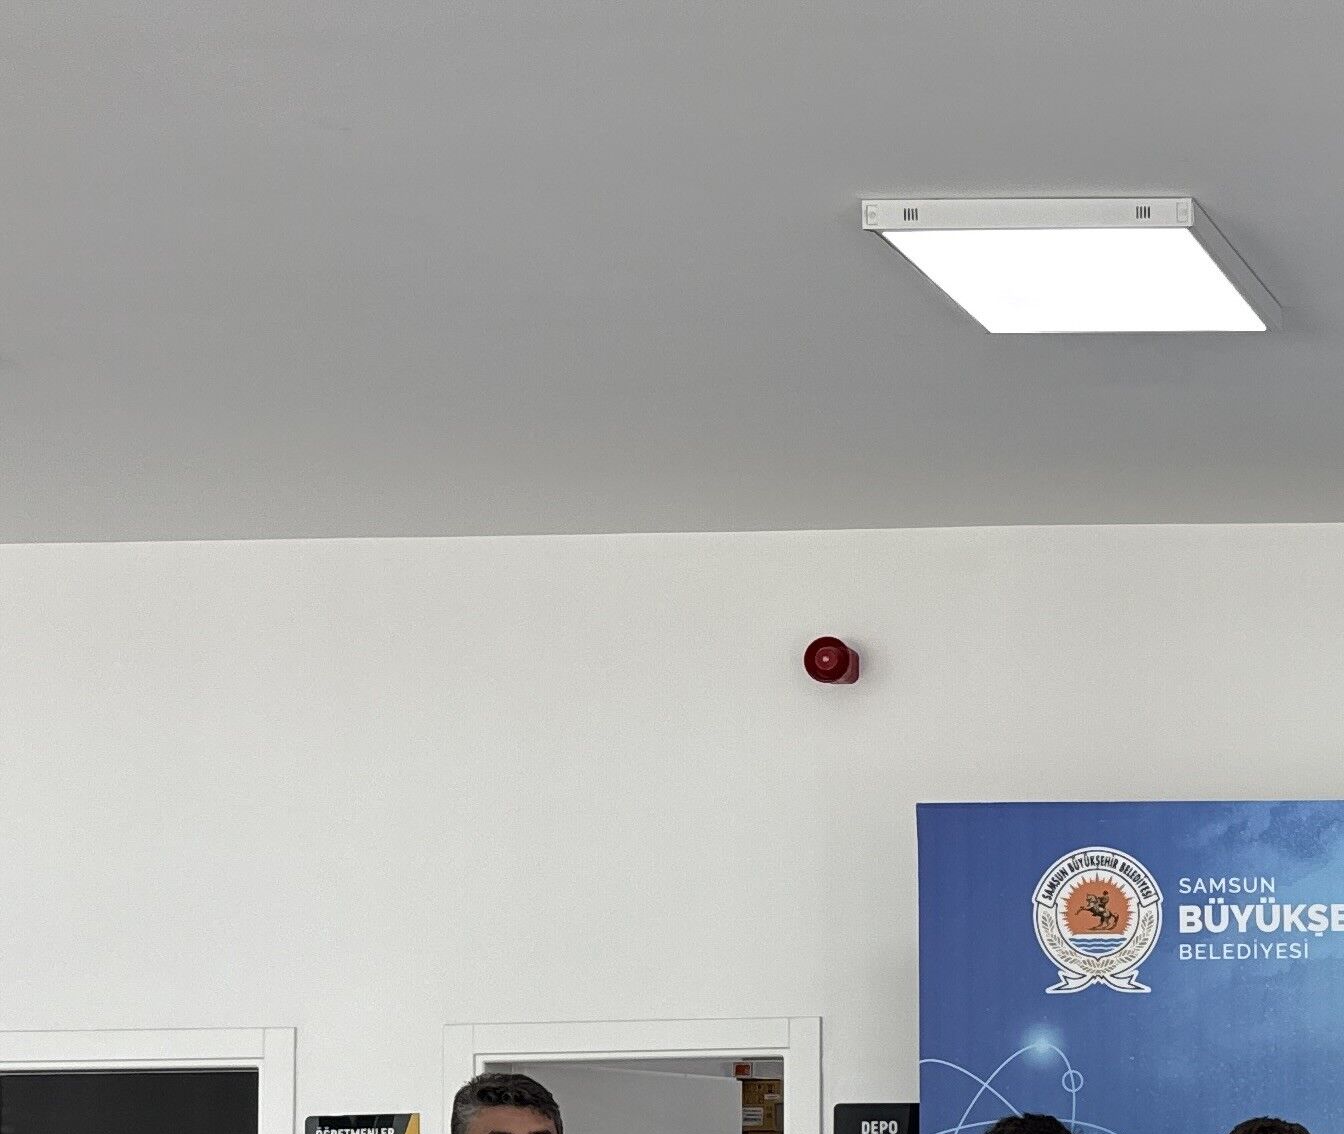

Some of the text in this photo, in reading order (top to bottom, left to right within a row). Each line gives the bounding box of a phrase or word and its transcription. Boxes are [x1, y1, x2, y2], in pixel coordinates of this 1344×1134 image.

[1041, 852, 1154, 900] SAMSUN BÜYÜKŞEHİR BELEDİYESİ
[1179, 877, 1276, 894] SAMSUN
[1179, 938, 1309, 960] BELEDİYESİ
[861, 1120, 898, 1134] DEPO
